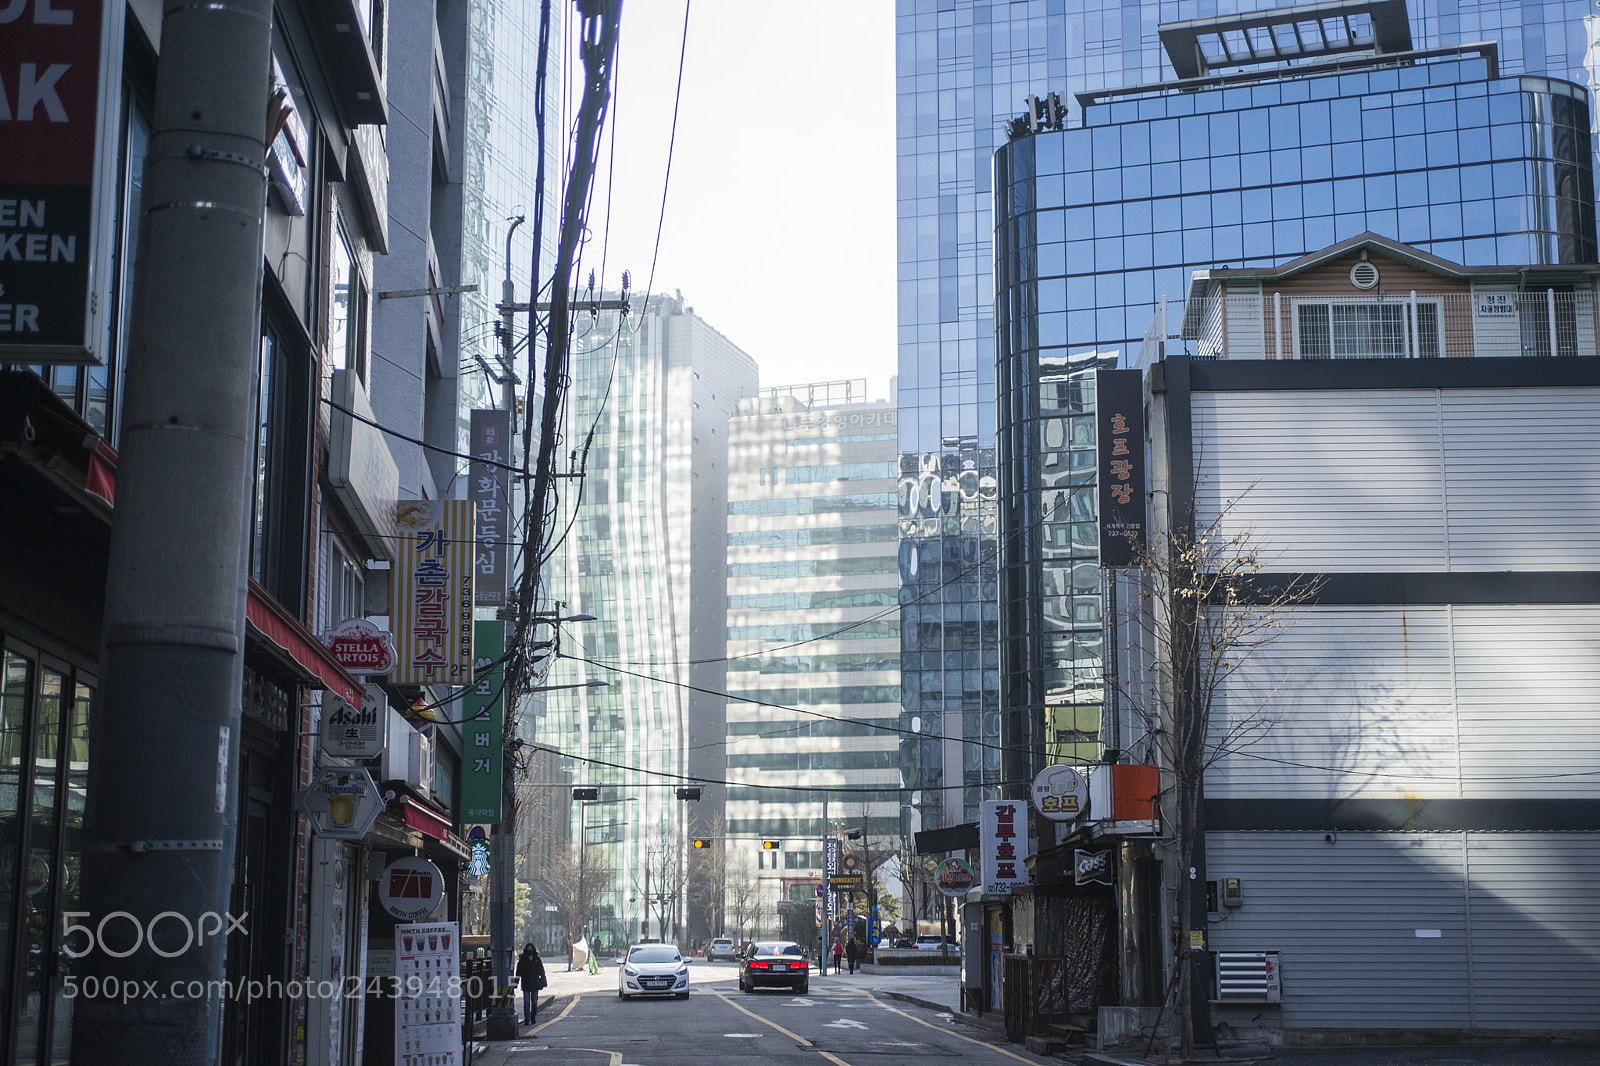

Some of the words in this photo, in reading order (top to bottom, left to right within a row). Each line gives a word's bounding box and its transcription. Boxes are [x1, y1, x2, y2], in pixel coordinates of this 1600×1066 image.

[0, 63, 72, 123] K
[1110, 413, 1133, 504] 호프광장
[475, 449, 502, 575] 광화문등심
[413, 528, 449, 677] 가촌칼국수
[336, 643, 379, 652] STELLA
[336, 653, 379, 663] ARTOIS
[451, 664, 467, 677] 2F
[329, 706, 377, 725] Asahi
[345, 728, 359, 738] 生
[474, 679, 492, 774] 모스버거
[1041, 795, 1079, 813] 호프
[995, 805, 1016, 879] 감투호프
[1079, 853, 1107, 874] Cass
[390, 905, 407, 918] MMTH
[408, 906, 430, 918] COFFEE
